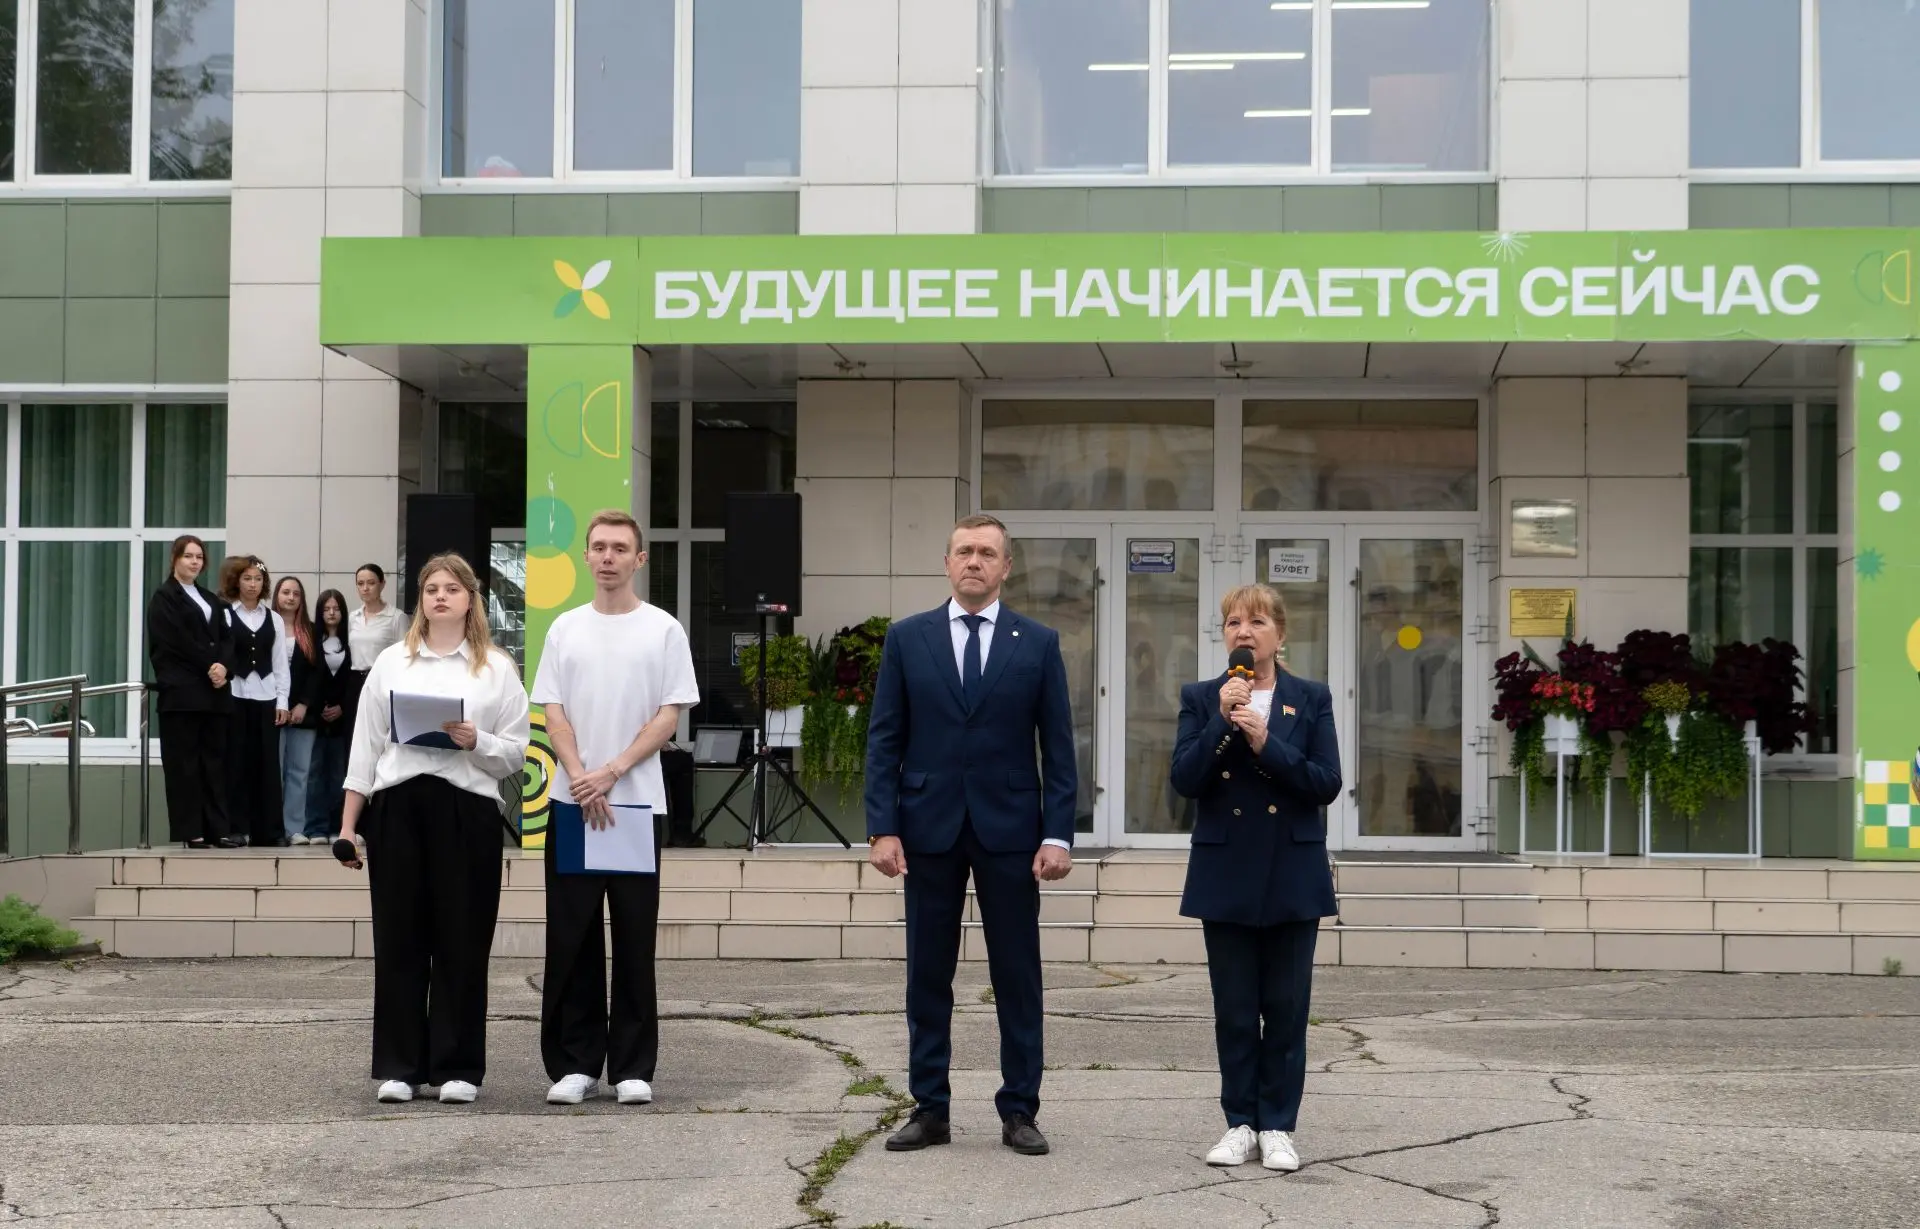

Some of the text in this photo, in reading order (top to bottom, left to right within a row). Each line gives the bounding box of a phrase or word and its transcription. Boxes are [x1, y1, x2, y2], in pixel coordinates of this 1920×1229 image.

[654, 248, 1821, 325] БУДУЩЕЕ НАЧИНАЕТСЯ СЕЙЧАС
[1274, 564, 1310, 575] БУФЕТ
